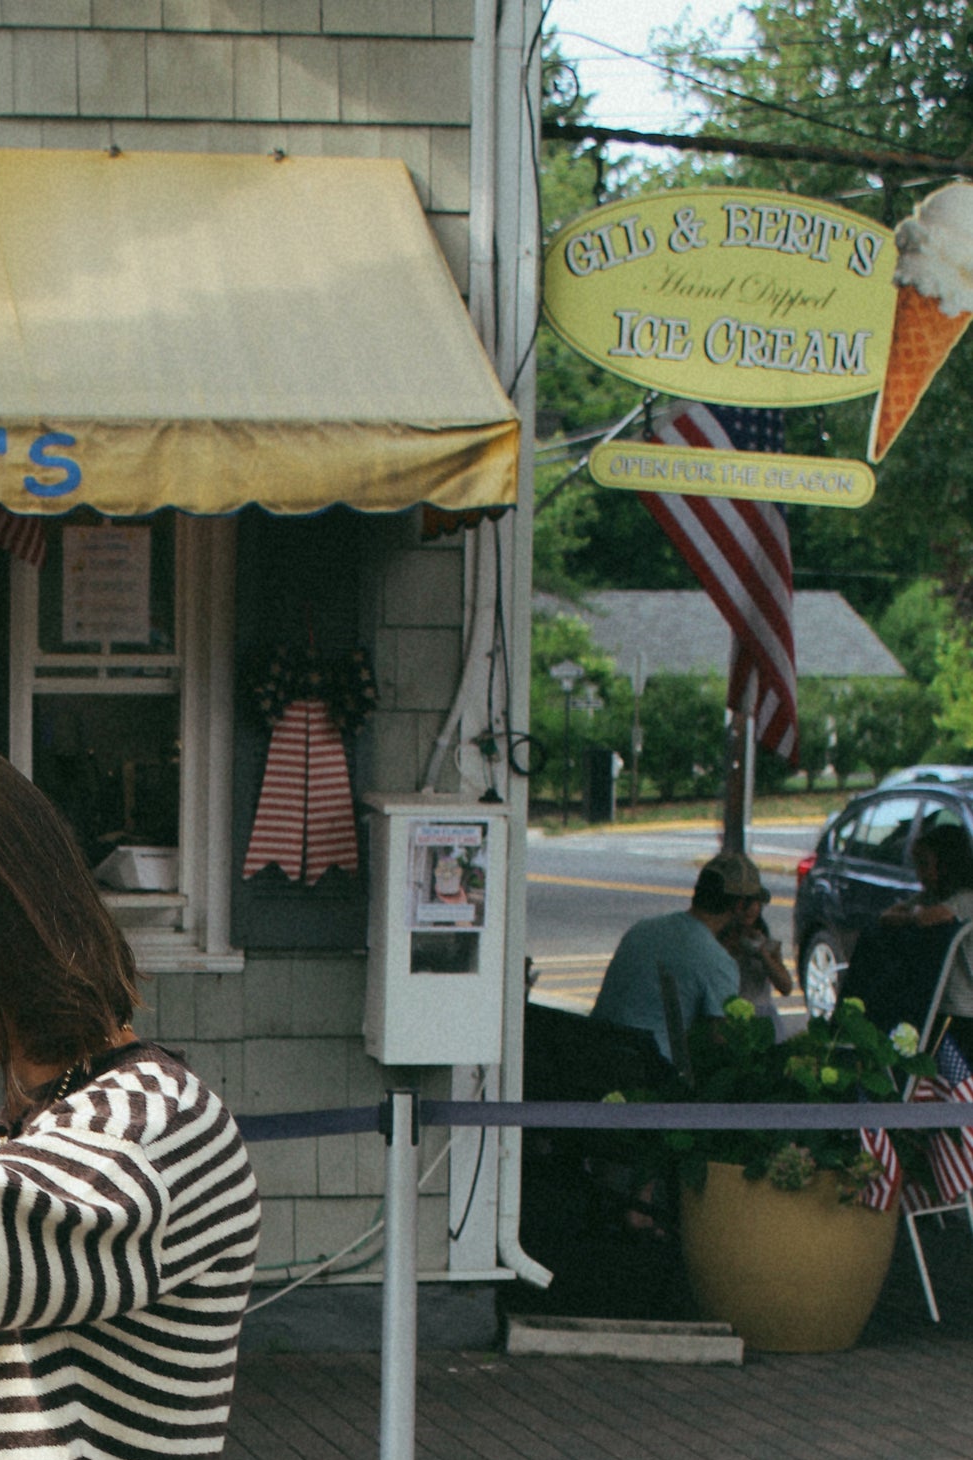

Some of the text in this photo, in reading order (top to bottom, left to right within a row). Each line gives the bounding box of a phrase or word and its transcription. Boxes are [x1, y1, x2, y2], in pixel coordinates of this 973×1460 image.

[564, 203, 884, 278] GIL & BERT'S
[643, 265, 837, 318] Hand Dipped
[608, 310, 873, 376] ICE CREAM
[610, 455, 856, 494] OPEN FOR THE SEASON
